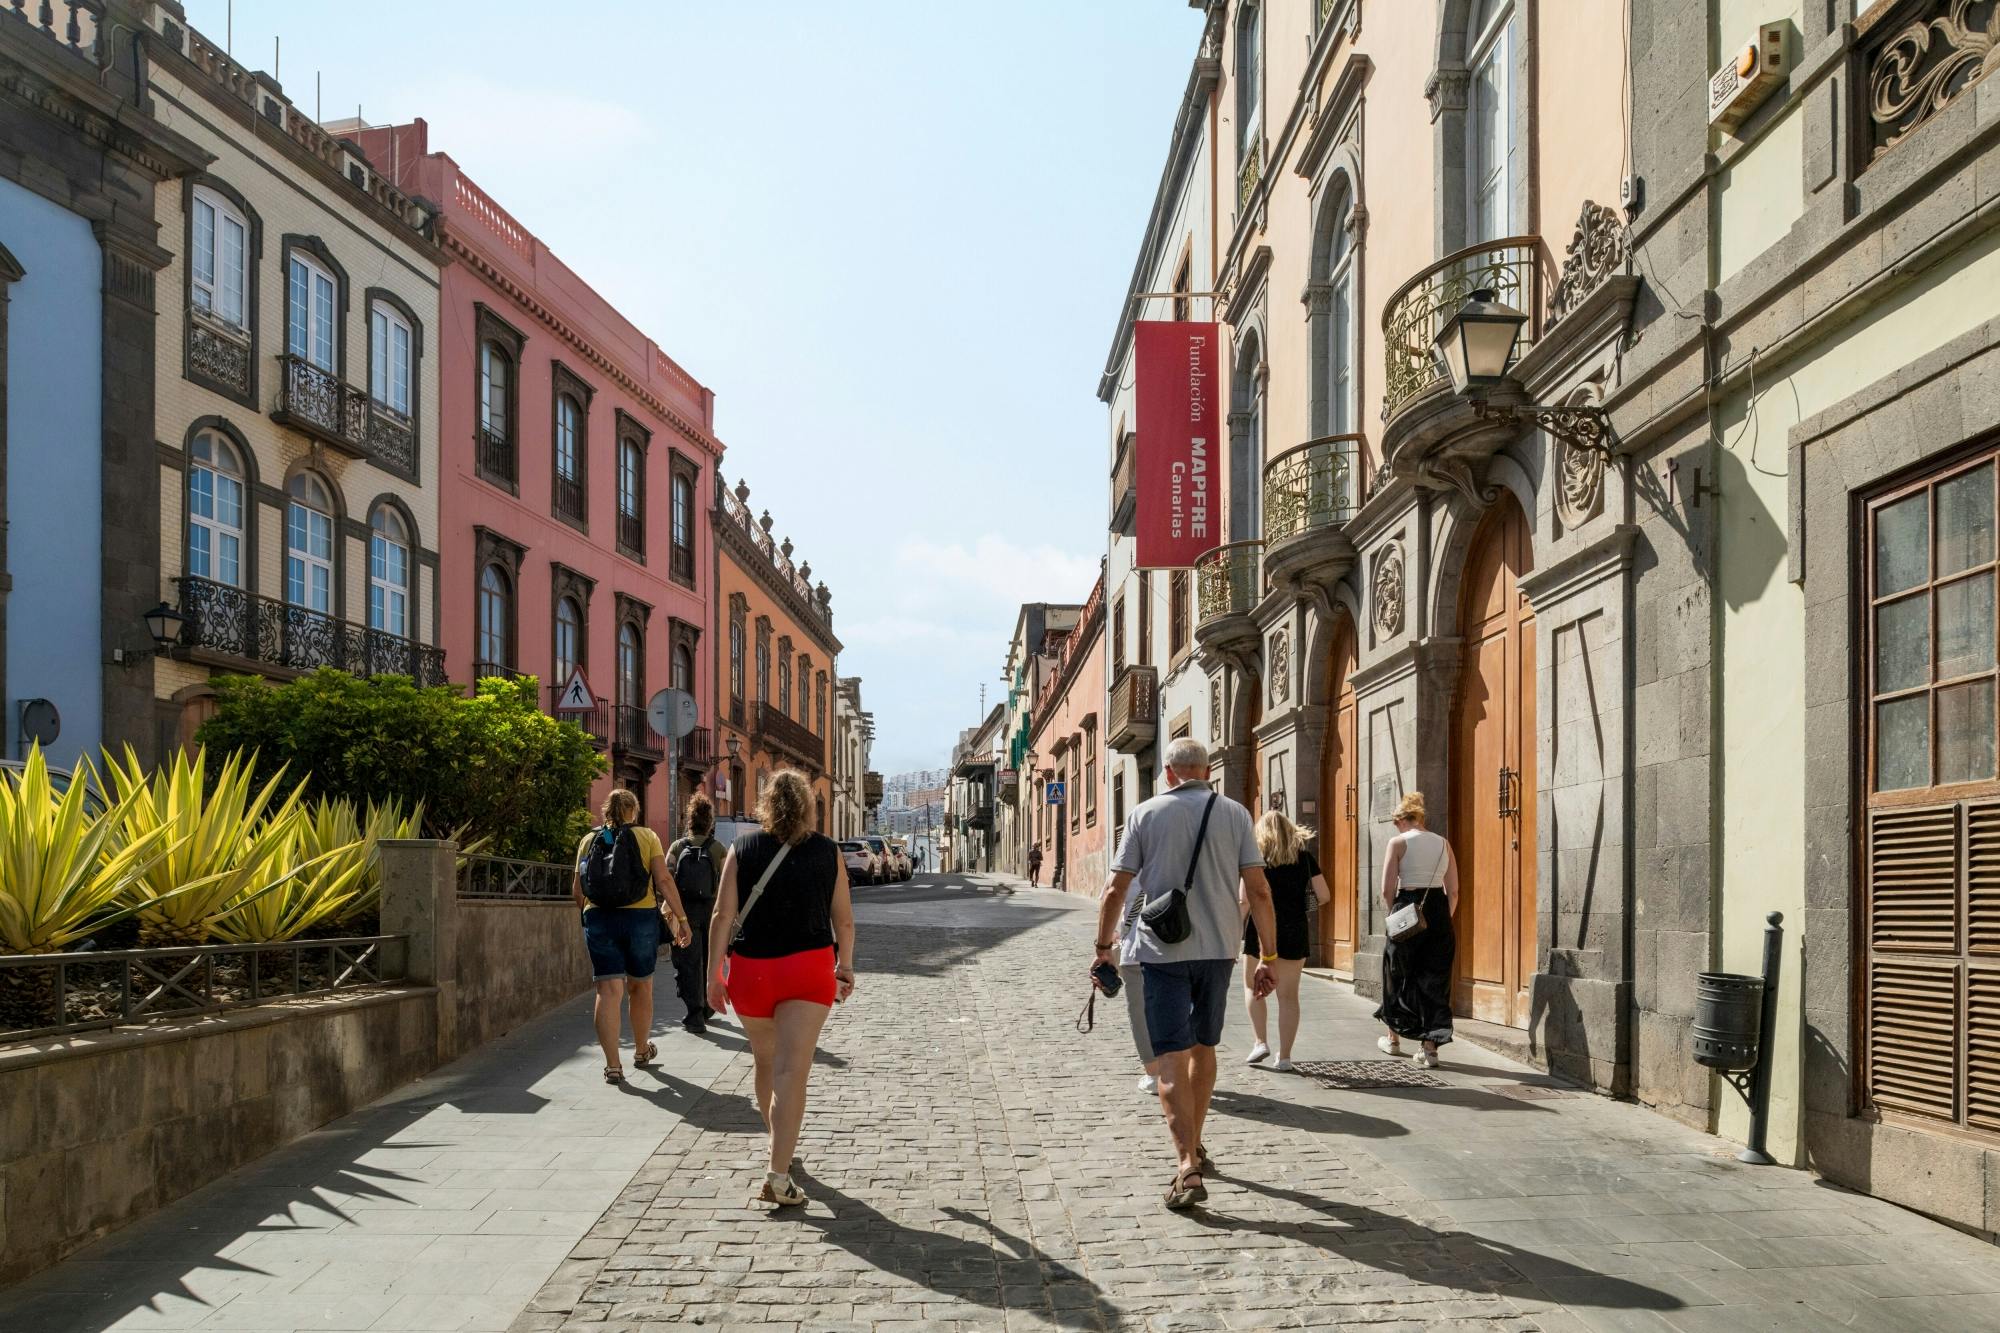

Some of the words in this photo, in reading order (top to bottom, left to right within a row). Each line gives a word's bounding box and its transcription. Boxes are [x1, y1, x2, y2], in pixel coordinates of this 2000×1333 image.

[1189, 335, 1207, 422] Fundación
[1171, 461, 1186, 538] Canarias
[1191, 437, 1207, 538] MAPFRE
